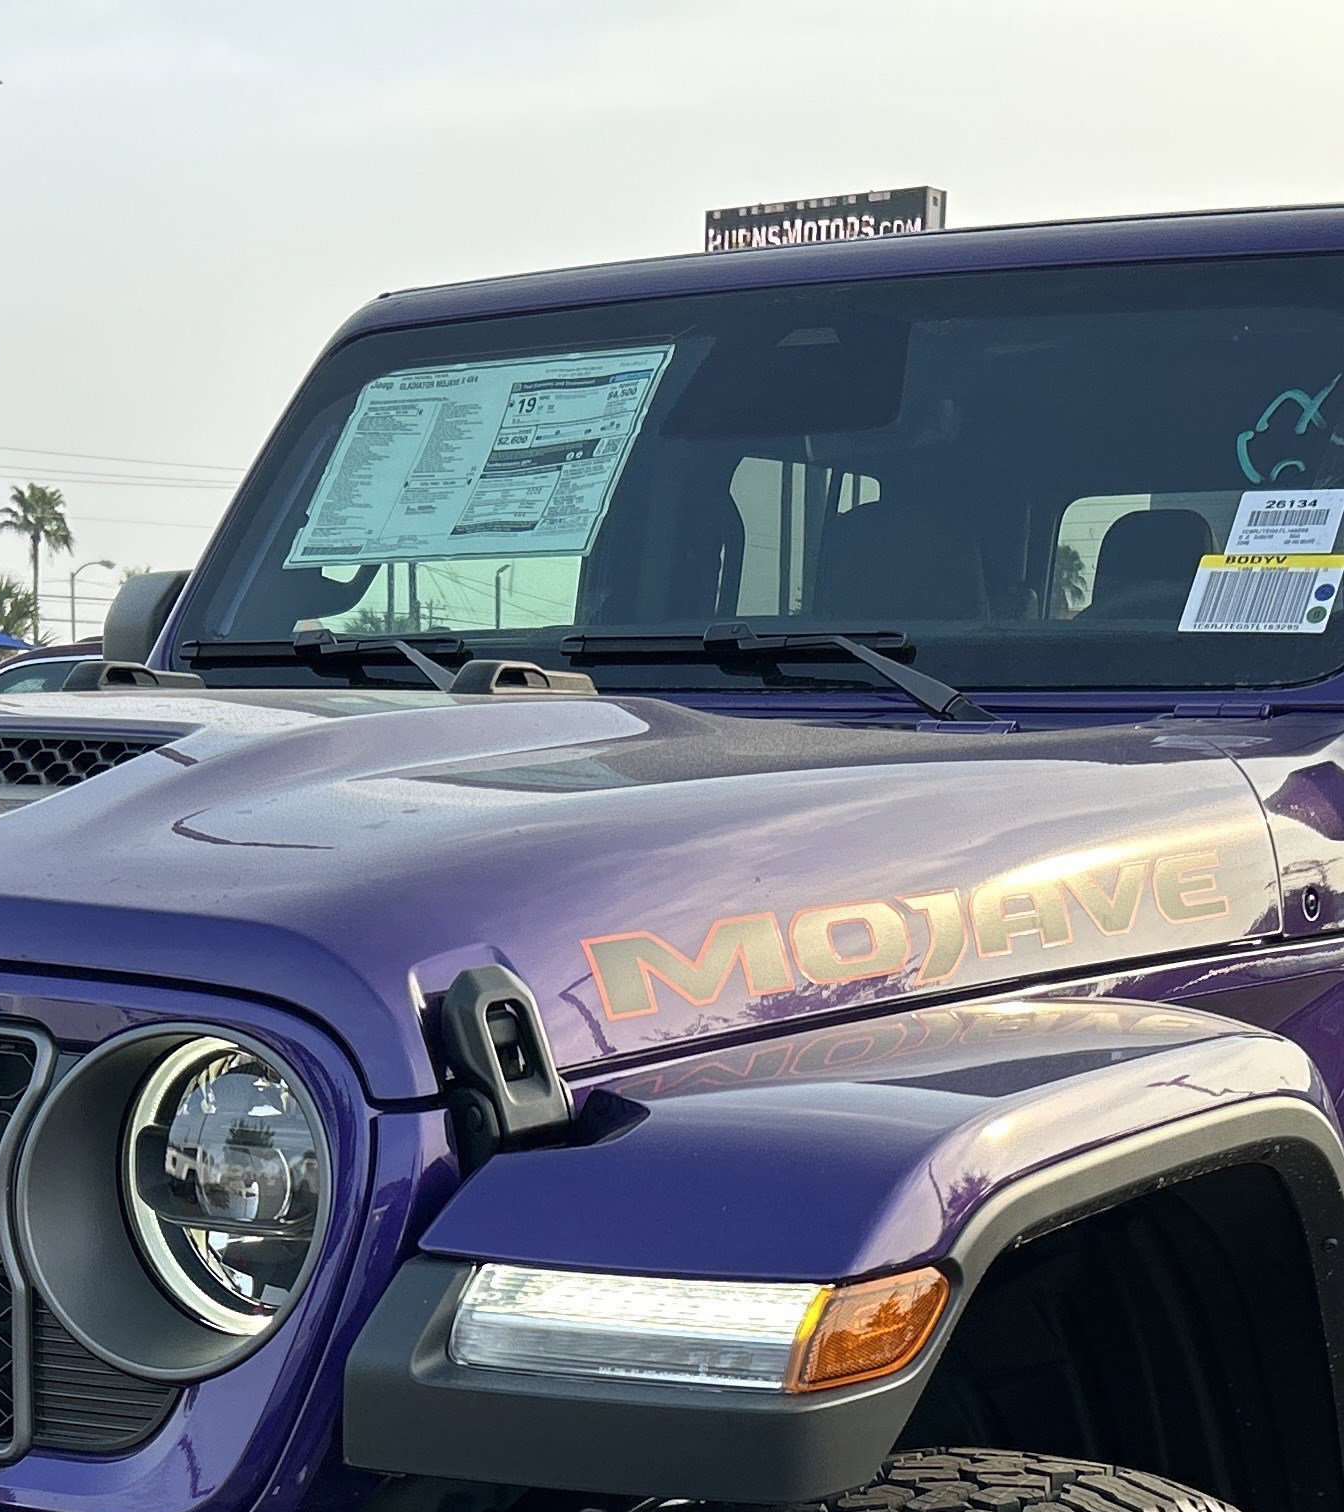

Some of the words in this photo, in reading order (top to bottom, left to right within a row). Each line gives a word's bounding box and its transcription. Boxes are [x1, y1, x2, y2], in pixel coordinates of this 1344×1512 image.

[517, 396, 537, 414] 19
[1264, 498, 1319, 509] 26134
[581, 849, 1231, 1022] MOJAVE
